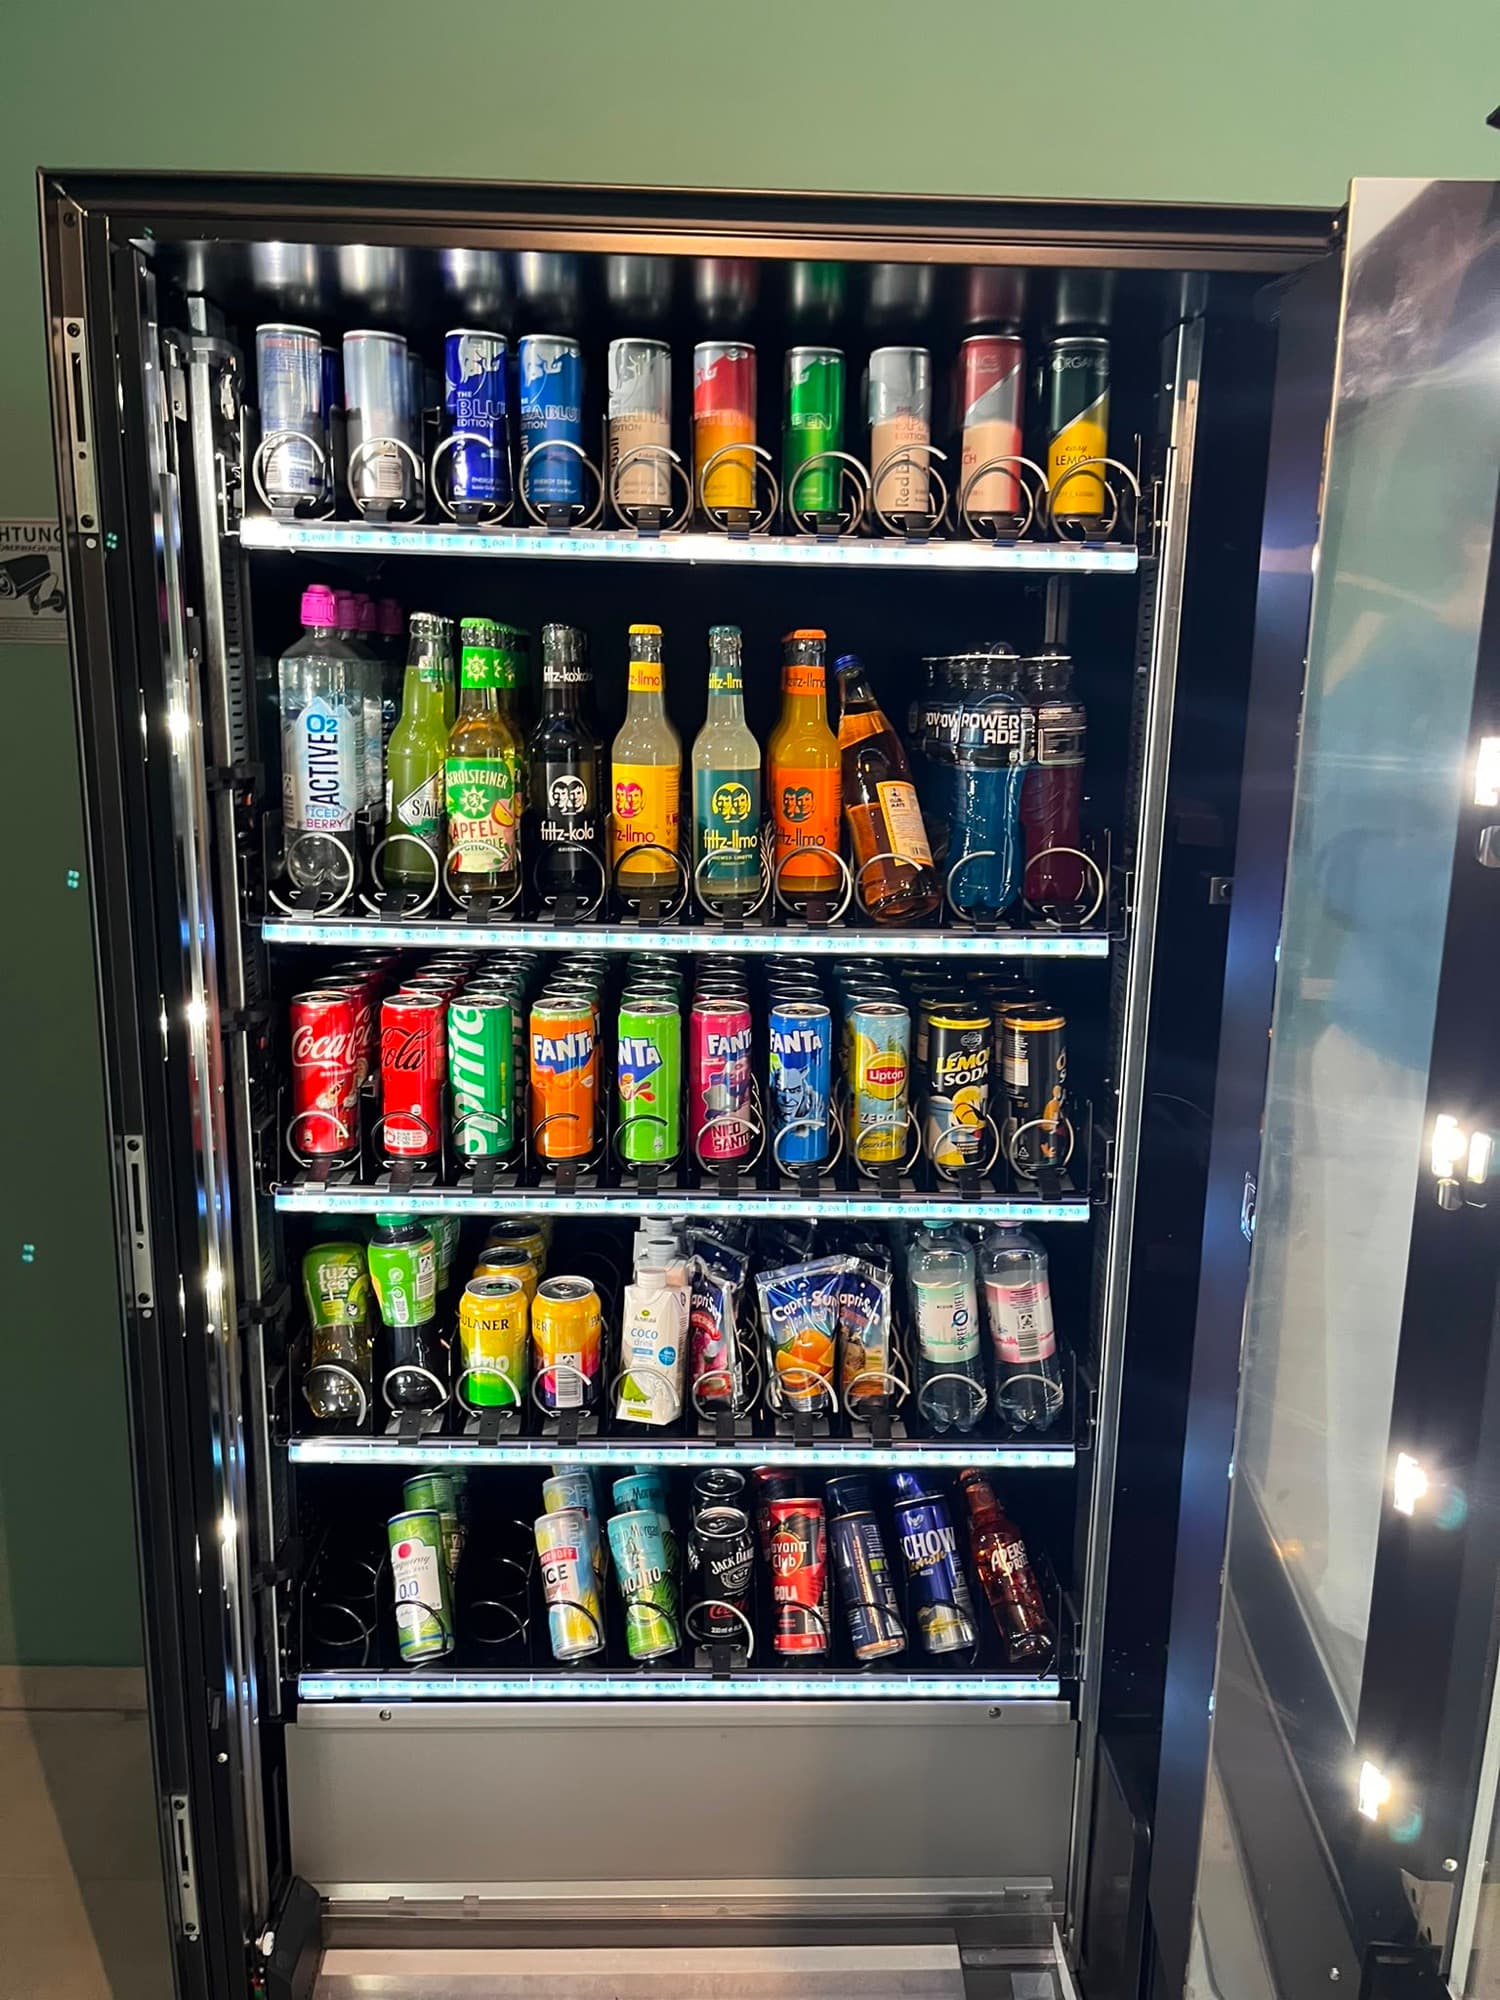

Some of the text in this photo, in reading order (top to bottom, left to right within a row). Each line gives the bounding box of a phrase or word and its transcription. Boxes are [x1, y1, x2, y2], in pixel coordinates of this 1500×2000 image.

[457, 399, 506, 420] BLU
[457, 420, 494, 428] EDITION
[961, 713, 1021, 730] POWER
[983, 729, 1020, 744] ADE
[308, 733, 340, 806] ACTIVE
[310, 807, 341, 818] ICED
[306, 818, 345, 829] BERRY
[451, 820, 498, 839] APFEL
[540, 820, 595, 841] fritz-kola
[703, 829, 758, 849] fritz-limo
[447, 1005, 499, 1156] Sprite
[869, 1068, 904, 1082] Lipton
[943, 1064, 989, 1086] SODA
[712, 1122, 741, 1138] NICO
[318, 1263, 358, 1282] fuze
[318, 1277, 350, 1292] tea
[711, 1555, 735, 1576] JACK
[772, 1553, 796, 1569] Club
[543, 1563, 569, 1586] ICE
[620, 1566, 662, 1599] MOJITO
[400, 1580, 419, 1600] 0.0
